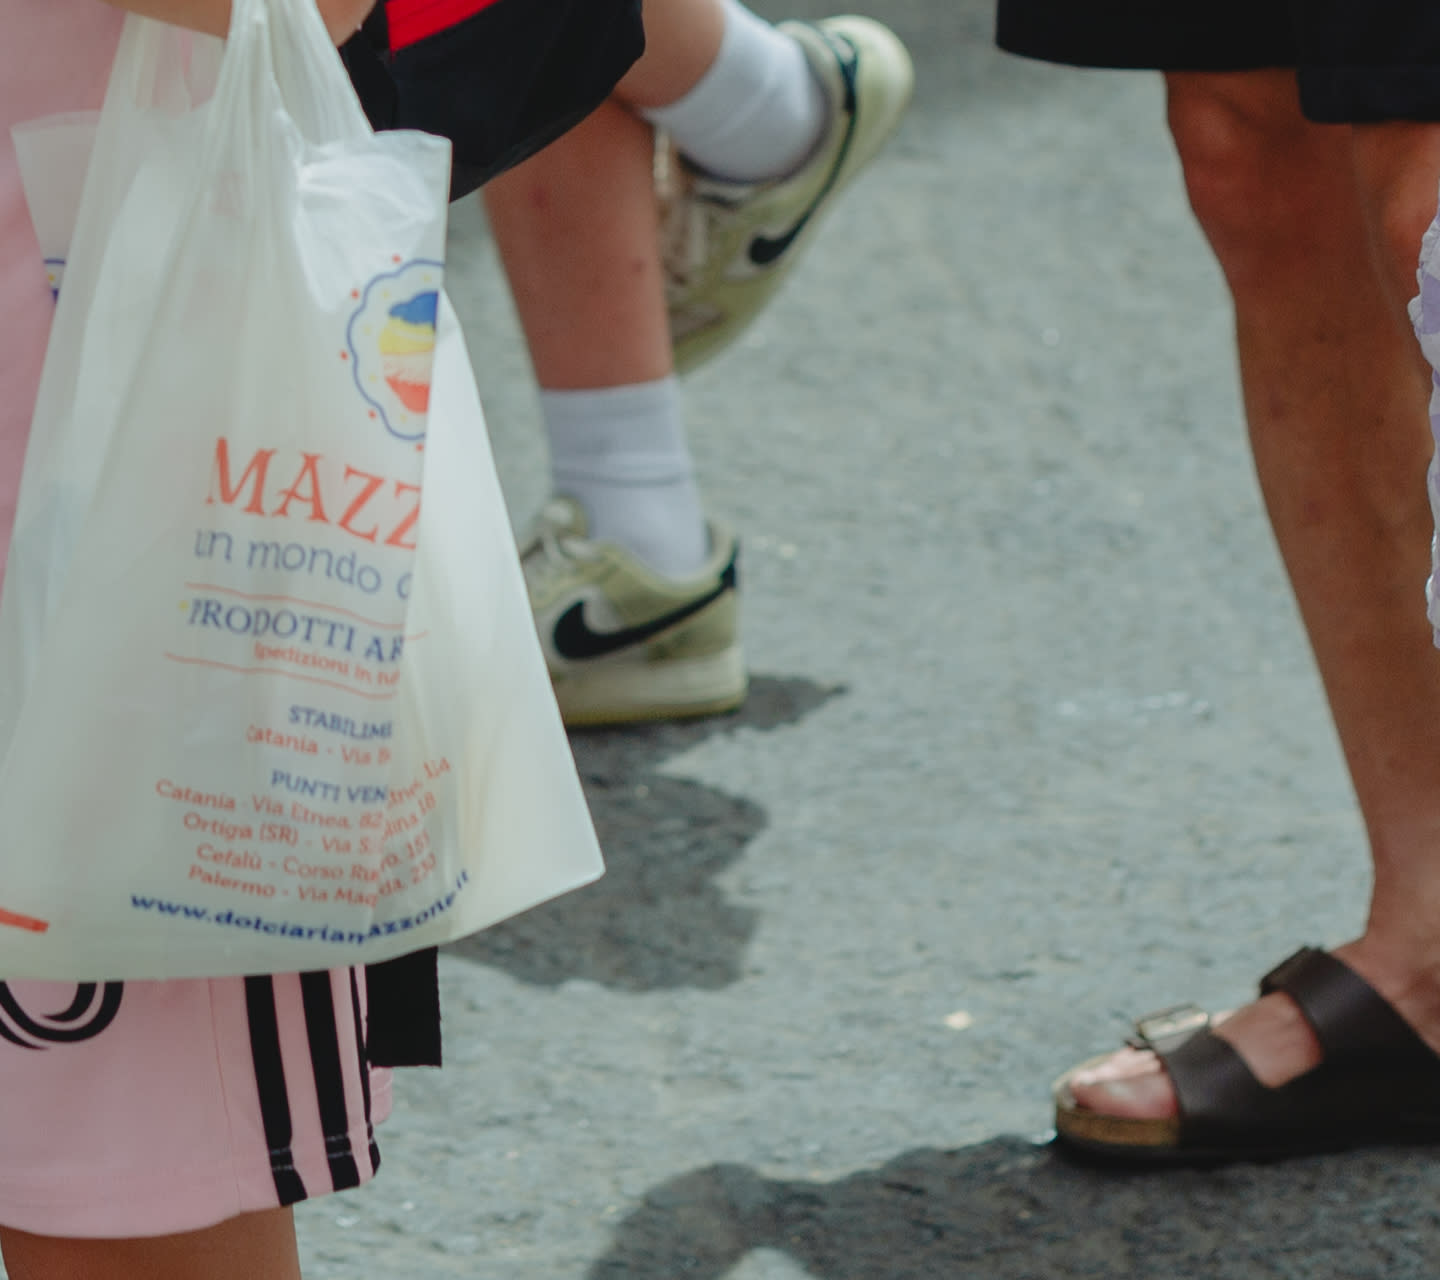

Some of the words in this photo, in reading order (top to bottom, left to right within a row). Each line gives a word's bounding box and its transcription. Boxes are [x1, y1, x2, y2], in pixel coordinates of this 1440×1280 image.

[205, 436, 420, 553] MAZZ
[247, 539, 382, 594] mondo
[155, 778, 236, 813] Catania
[251, 794, 284, 817] Via
[271, 769, 341, 804] PUNTI
[188, 864, 277, 899] Palermo
[297, 884, 329, 903] Via
[283, 855, 344, 880] Corso
